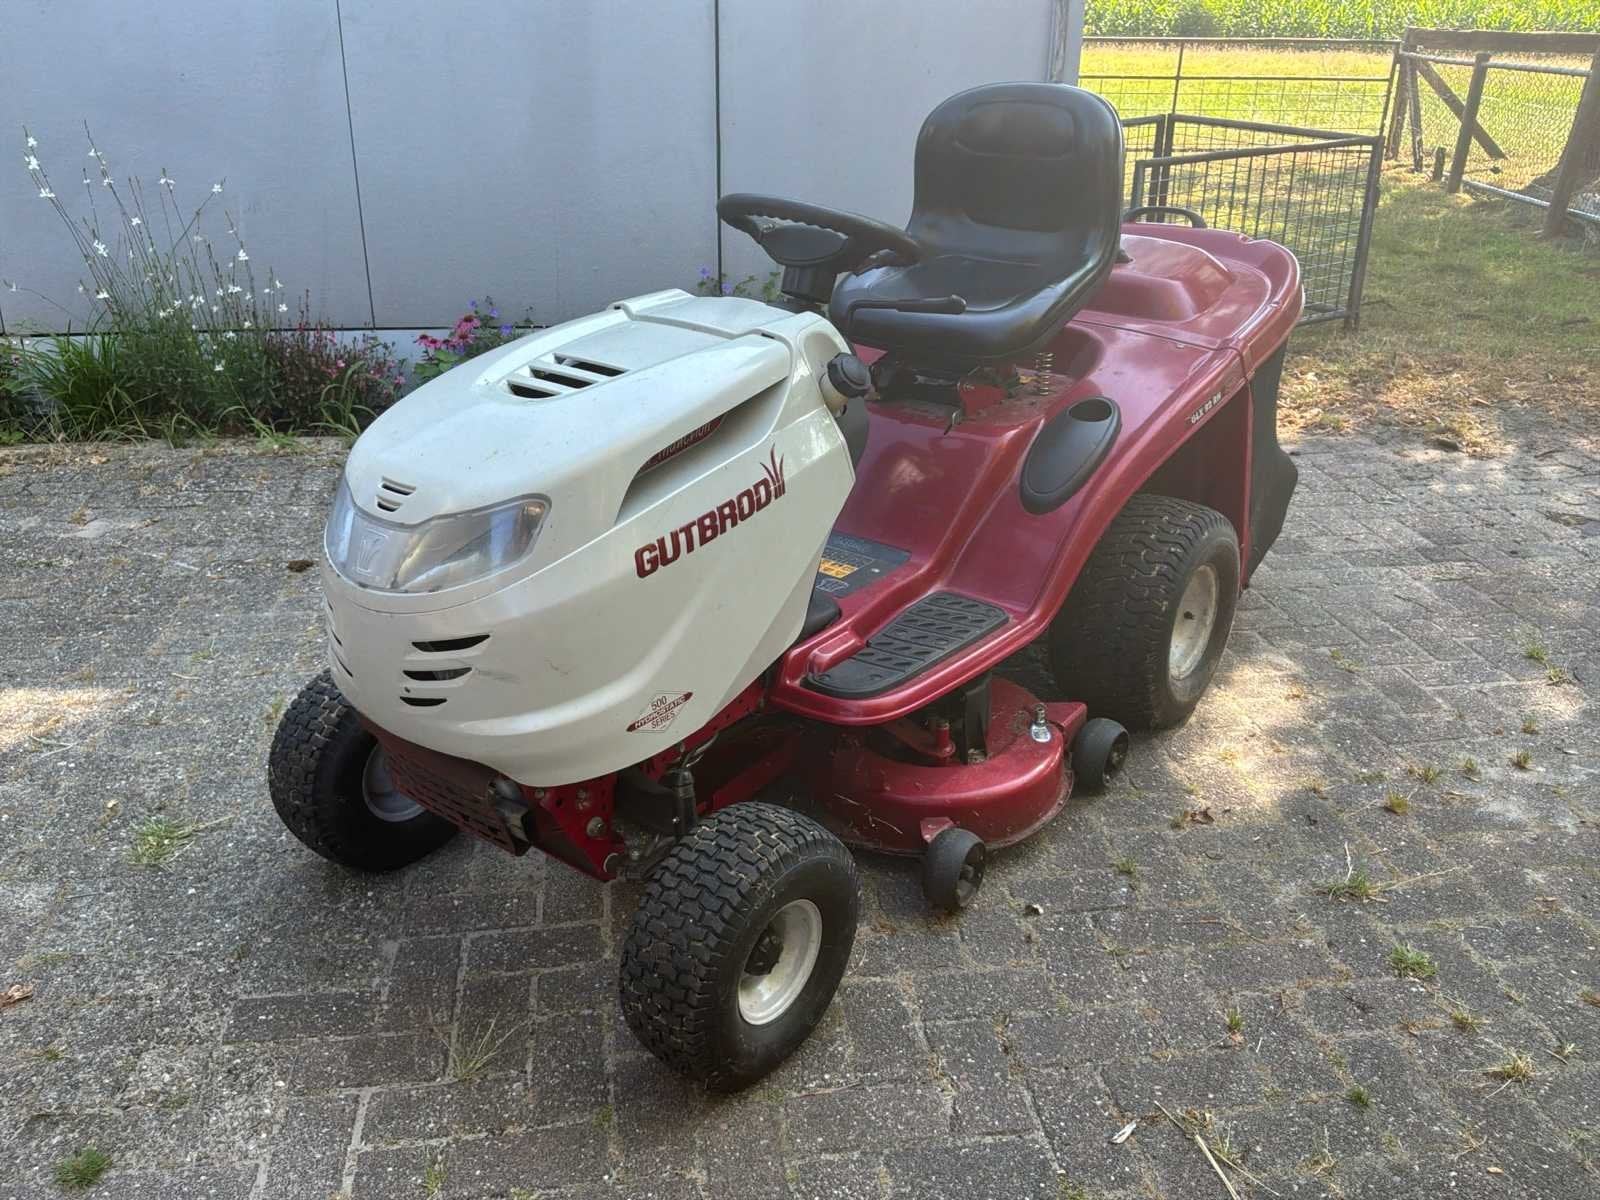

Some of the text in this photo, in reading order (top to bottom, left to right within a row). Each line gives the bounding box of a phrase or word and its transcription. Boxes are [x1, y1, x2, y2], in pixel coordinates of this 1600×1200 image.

[634, 477, 773, 579] GUTBROD
[651, 695, 667, 711] 500
[651, 711, 676, 729] SERIES
